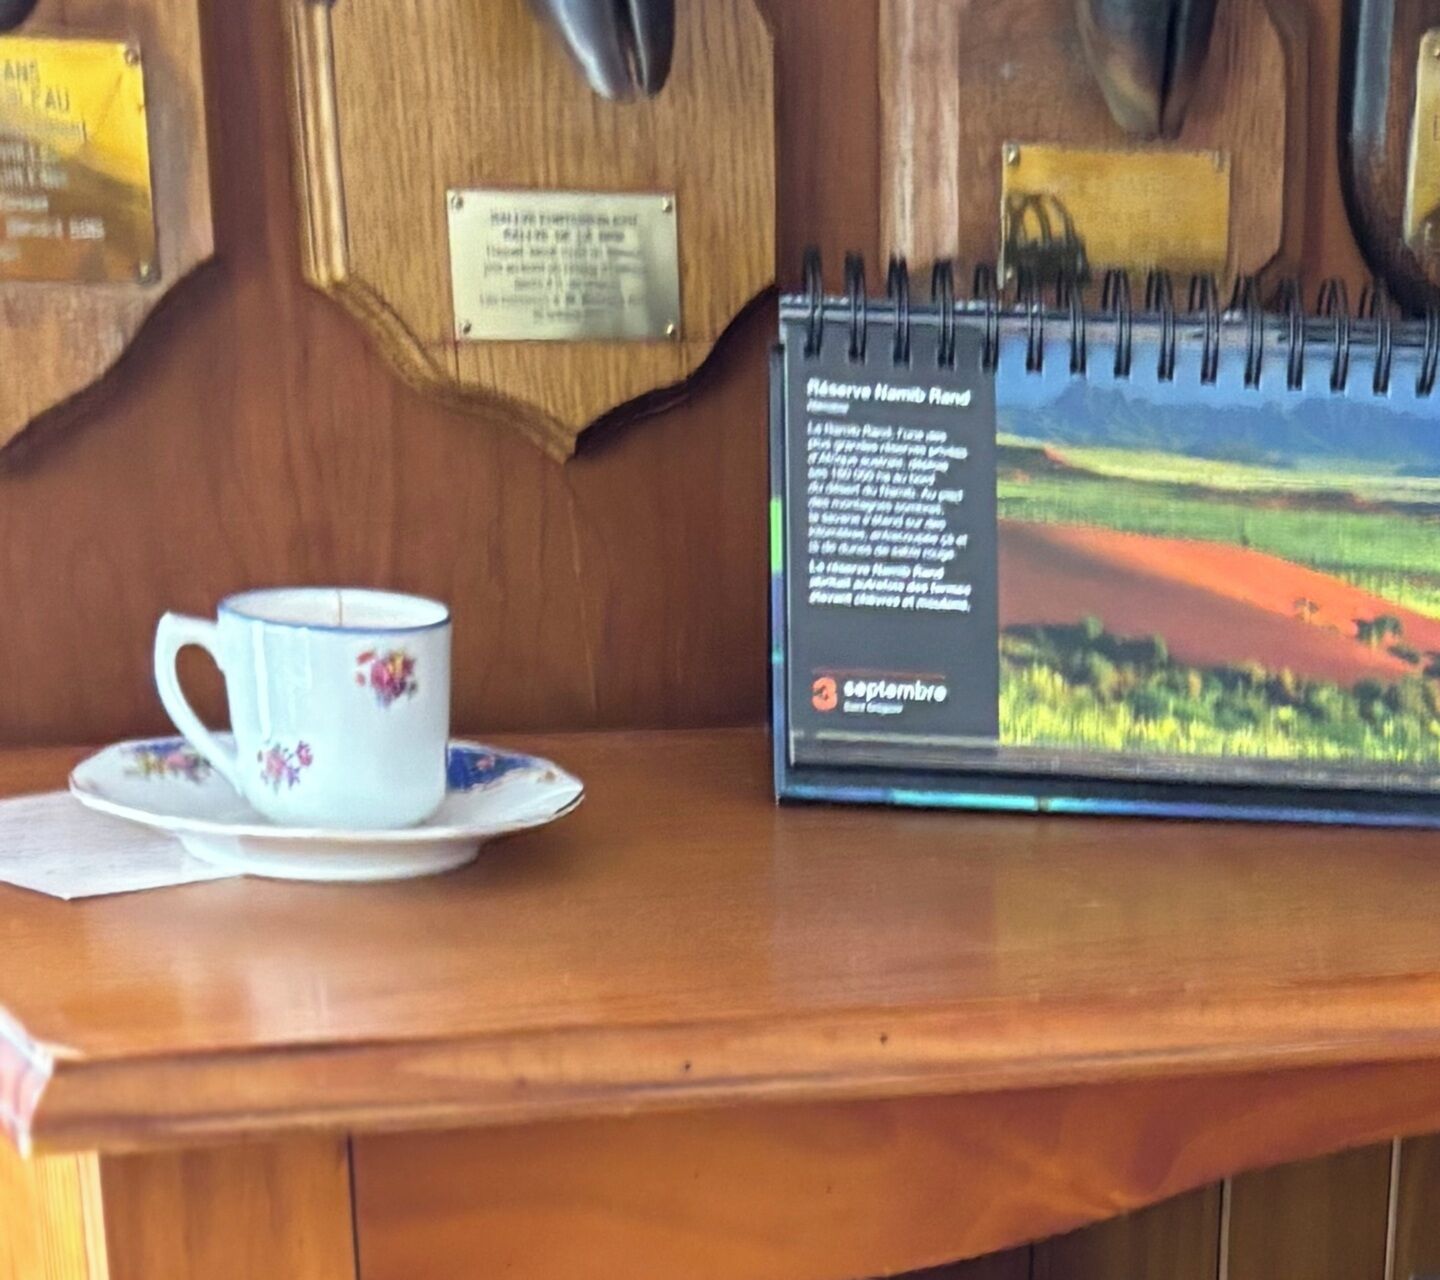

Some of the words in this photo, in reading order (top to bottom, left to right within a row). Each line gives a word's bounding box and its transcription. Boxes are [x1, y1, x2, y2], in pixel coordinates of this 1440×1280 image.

[807, 377, 872, 400] Réserve
[812, 676, 839, 713] 3
[844, 680, 948, 705] septembre
